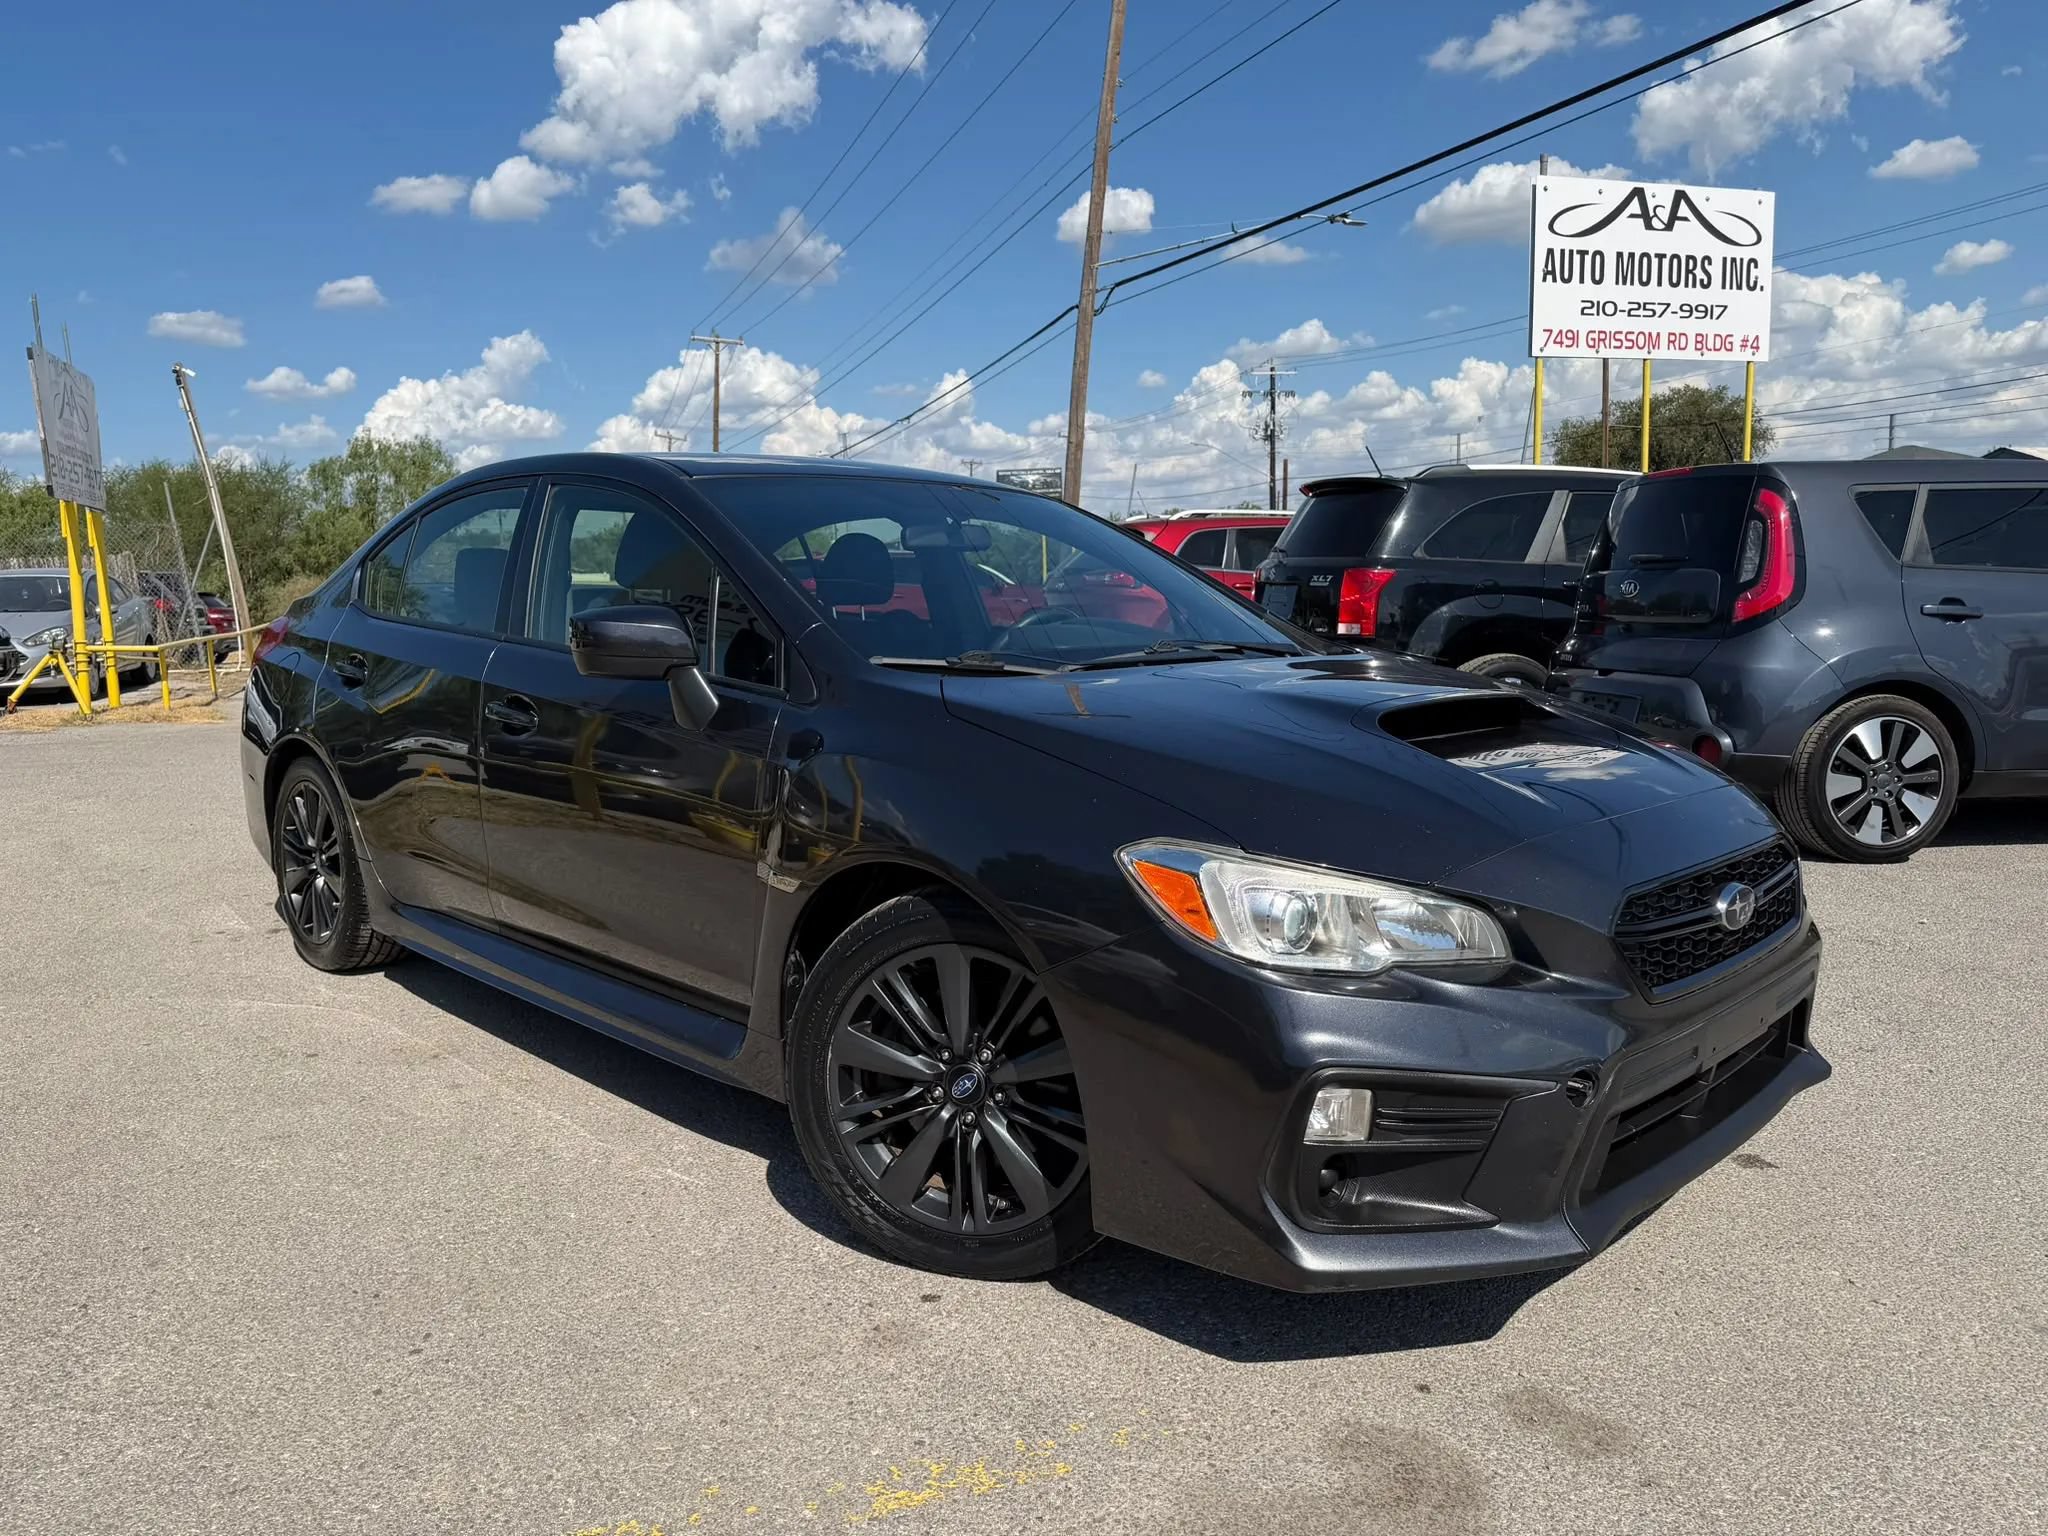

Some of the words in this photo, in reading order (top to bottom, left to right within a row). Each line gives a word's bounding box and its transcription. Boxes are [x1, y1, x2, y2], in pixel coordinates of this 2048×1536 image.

[1548, 186, 1762, 247] A&A
[1541, 247, 1605, 286] AUTO
[1614, 251, 1713, 290] MOTORS
[1721, 256, 1764, 293] INC.
[1580, 299, 1728, 321] 210-257-9917
[1542, 328, 1580, 349] 7491
[1585, 330, 1661, 351] GRISSOM
[1667, 332, 1689, 351] RD
[1694, 332, 1734, 352] BLDG
[1739, 334, 1760, 353] #4
[1311, 574, 1334, 582] XLT
